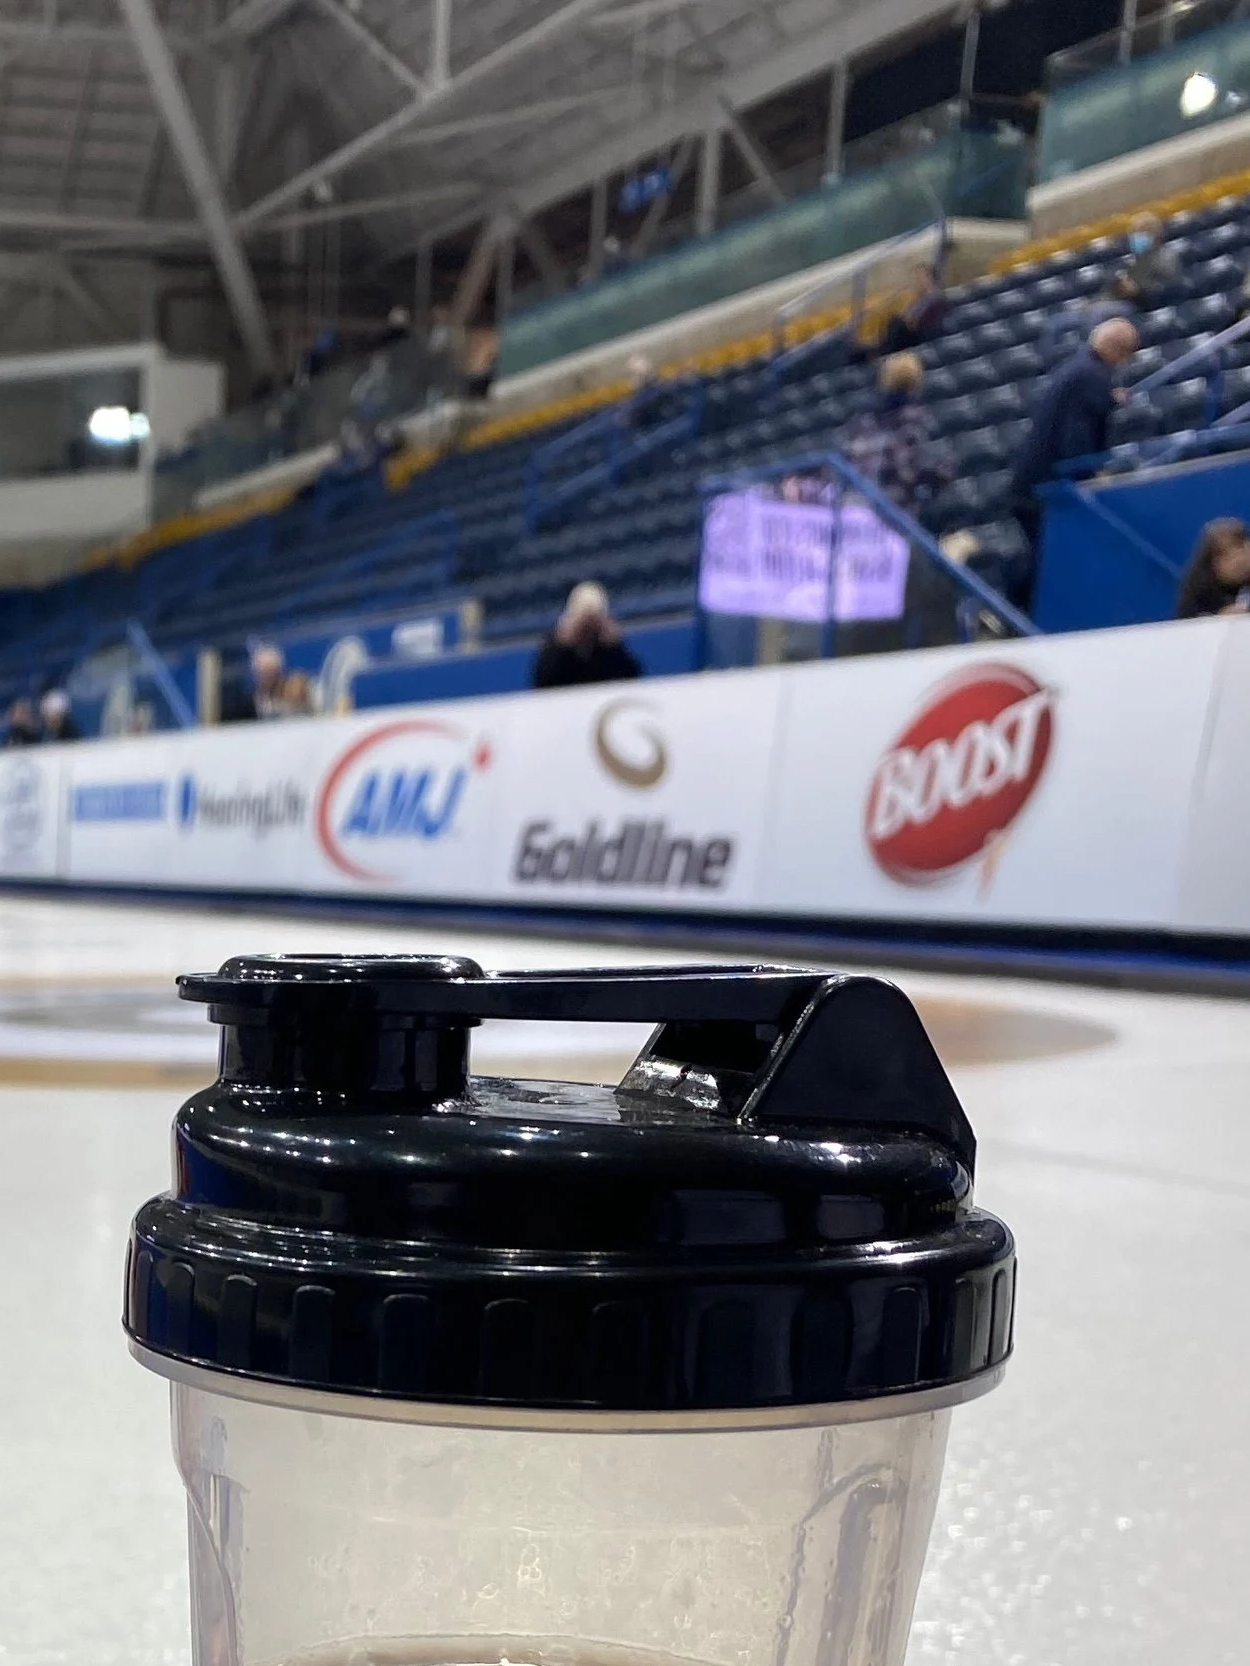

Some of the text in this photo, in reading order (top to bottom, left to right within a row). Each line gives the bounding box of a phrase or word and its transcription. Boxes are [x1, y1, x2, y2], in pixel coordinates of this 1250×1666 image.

[870, 688, 1058, 840] BOOST
[338, 766, 468, 840] AMJ
[513, 817, 734, 889] Goldline
